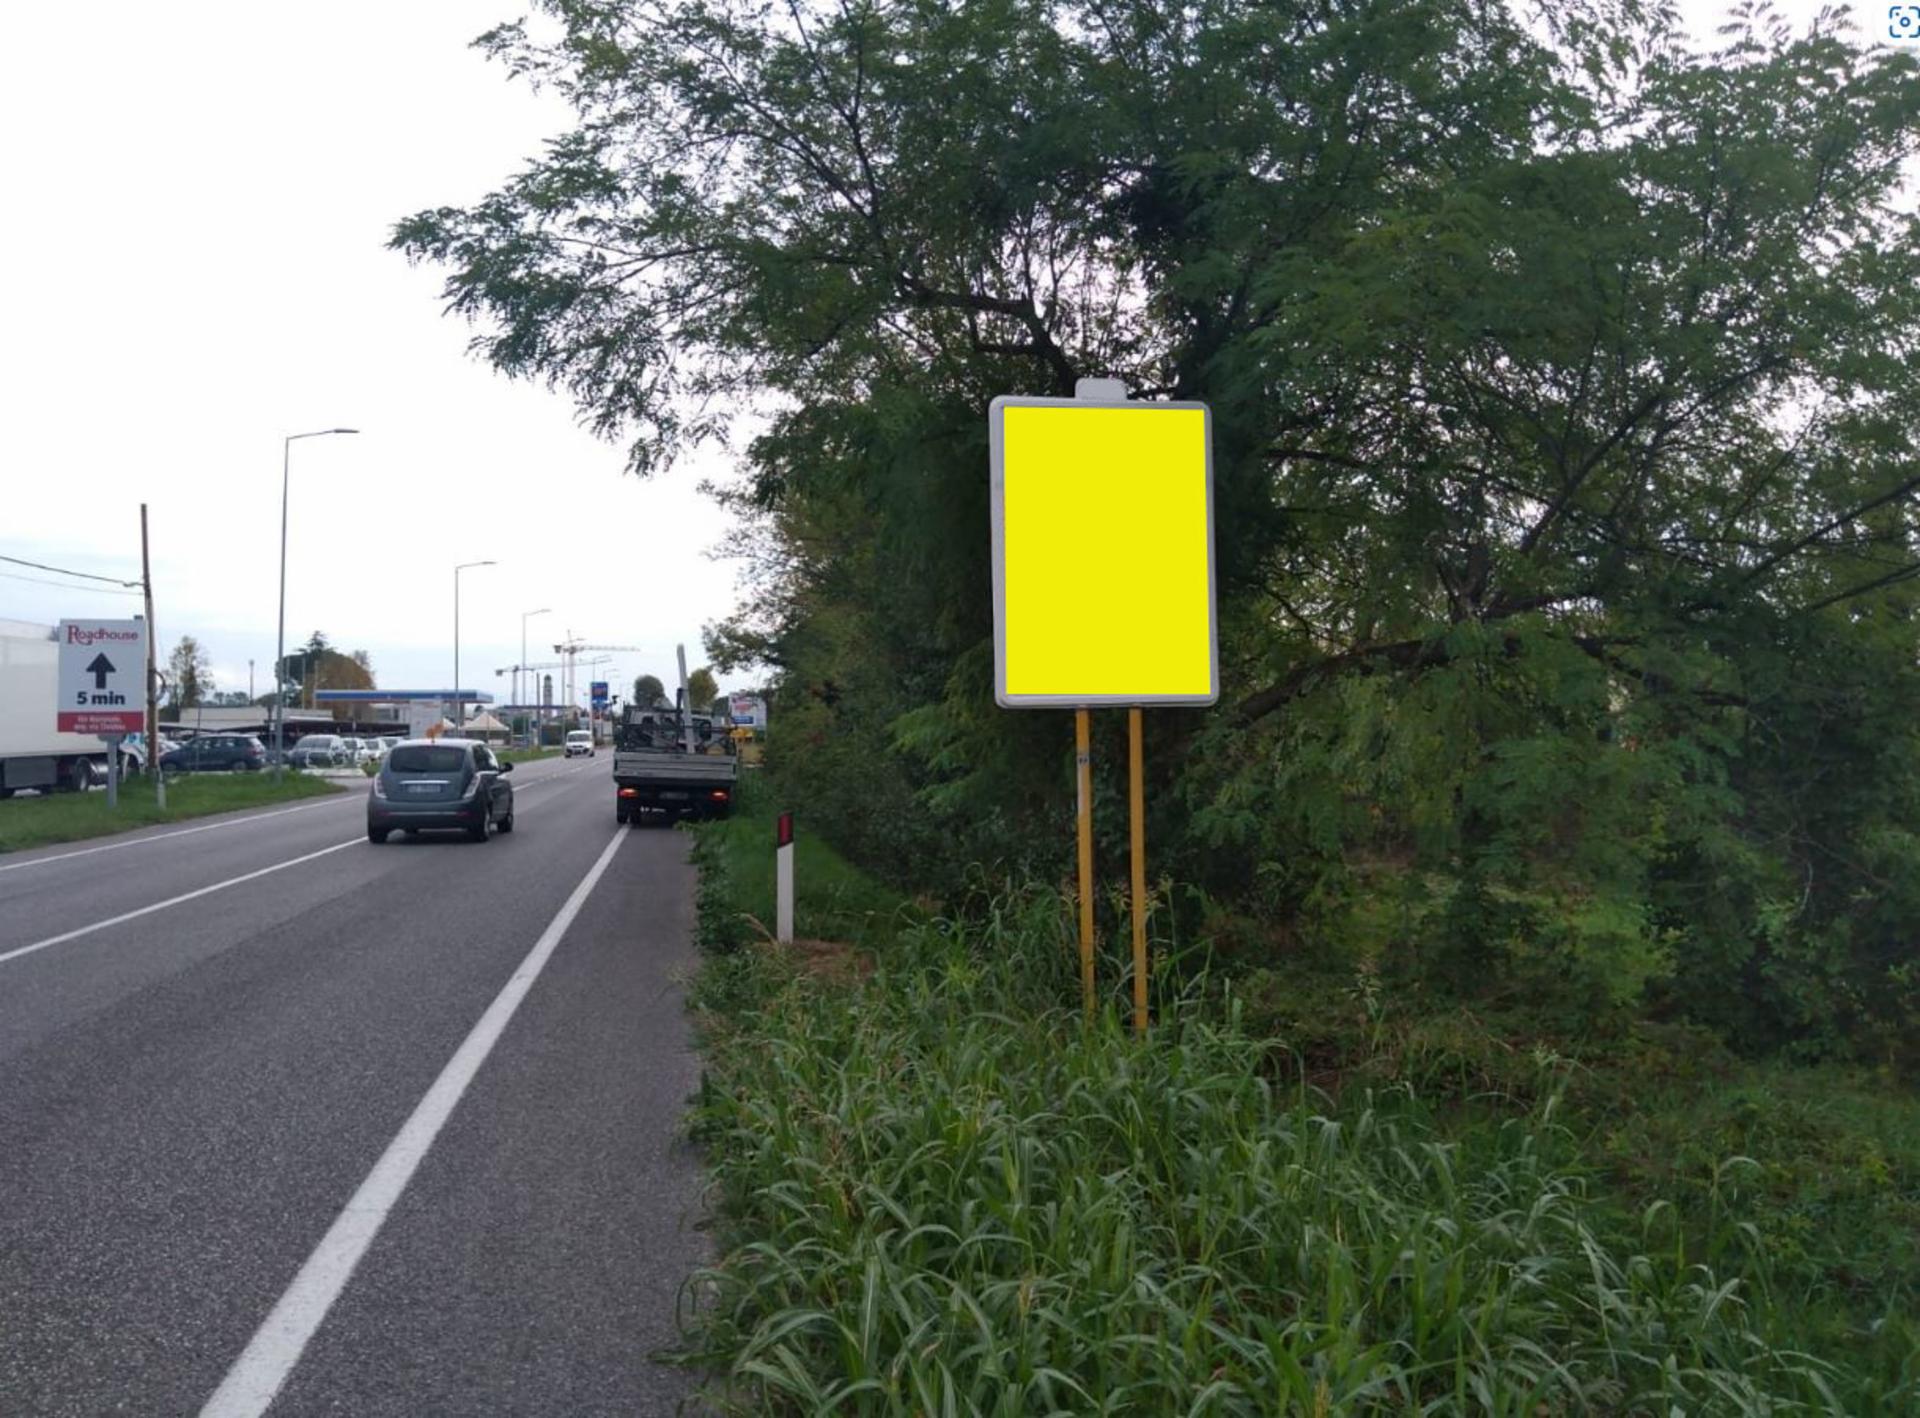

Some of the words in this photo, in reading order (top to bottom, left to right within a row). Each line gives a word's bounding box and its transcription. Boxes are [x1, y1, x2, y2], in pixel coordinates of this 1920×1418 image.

[67, 625, 138, 646] Roadhouse
[77, 691, 88, 705] 5
[91, 691, 126, 705] min
